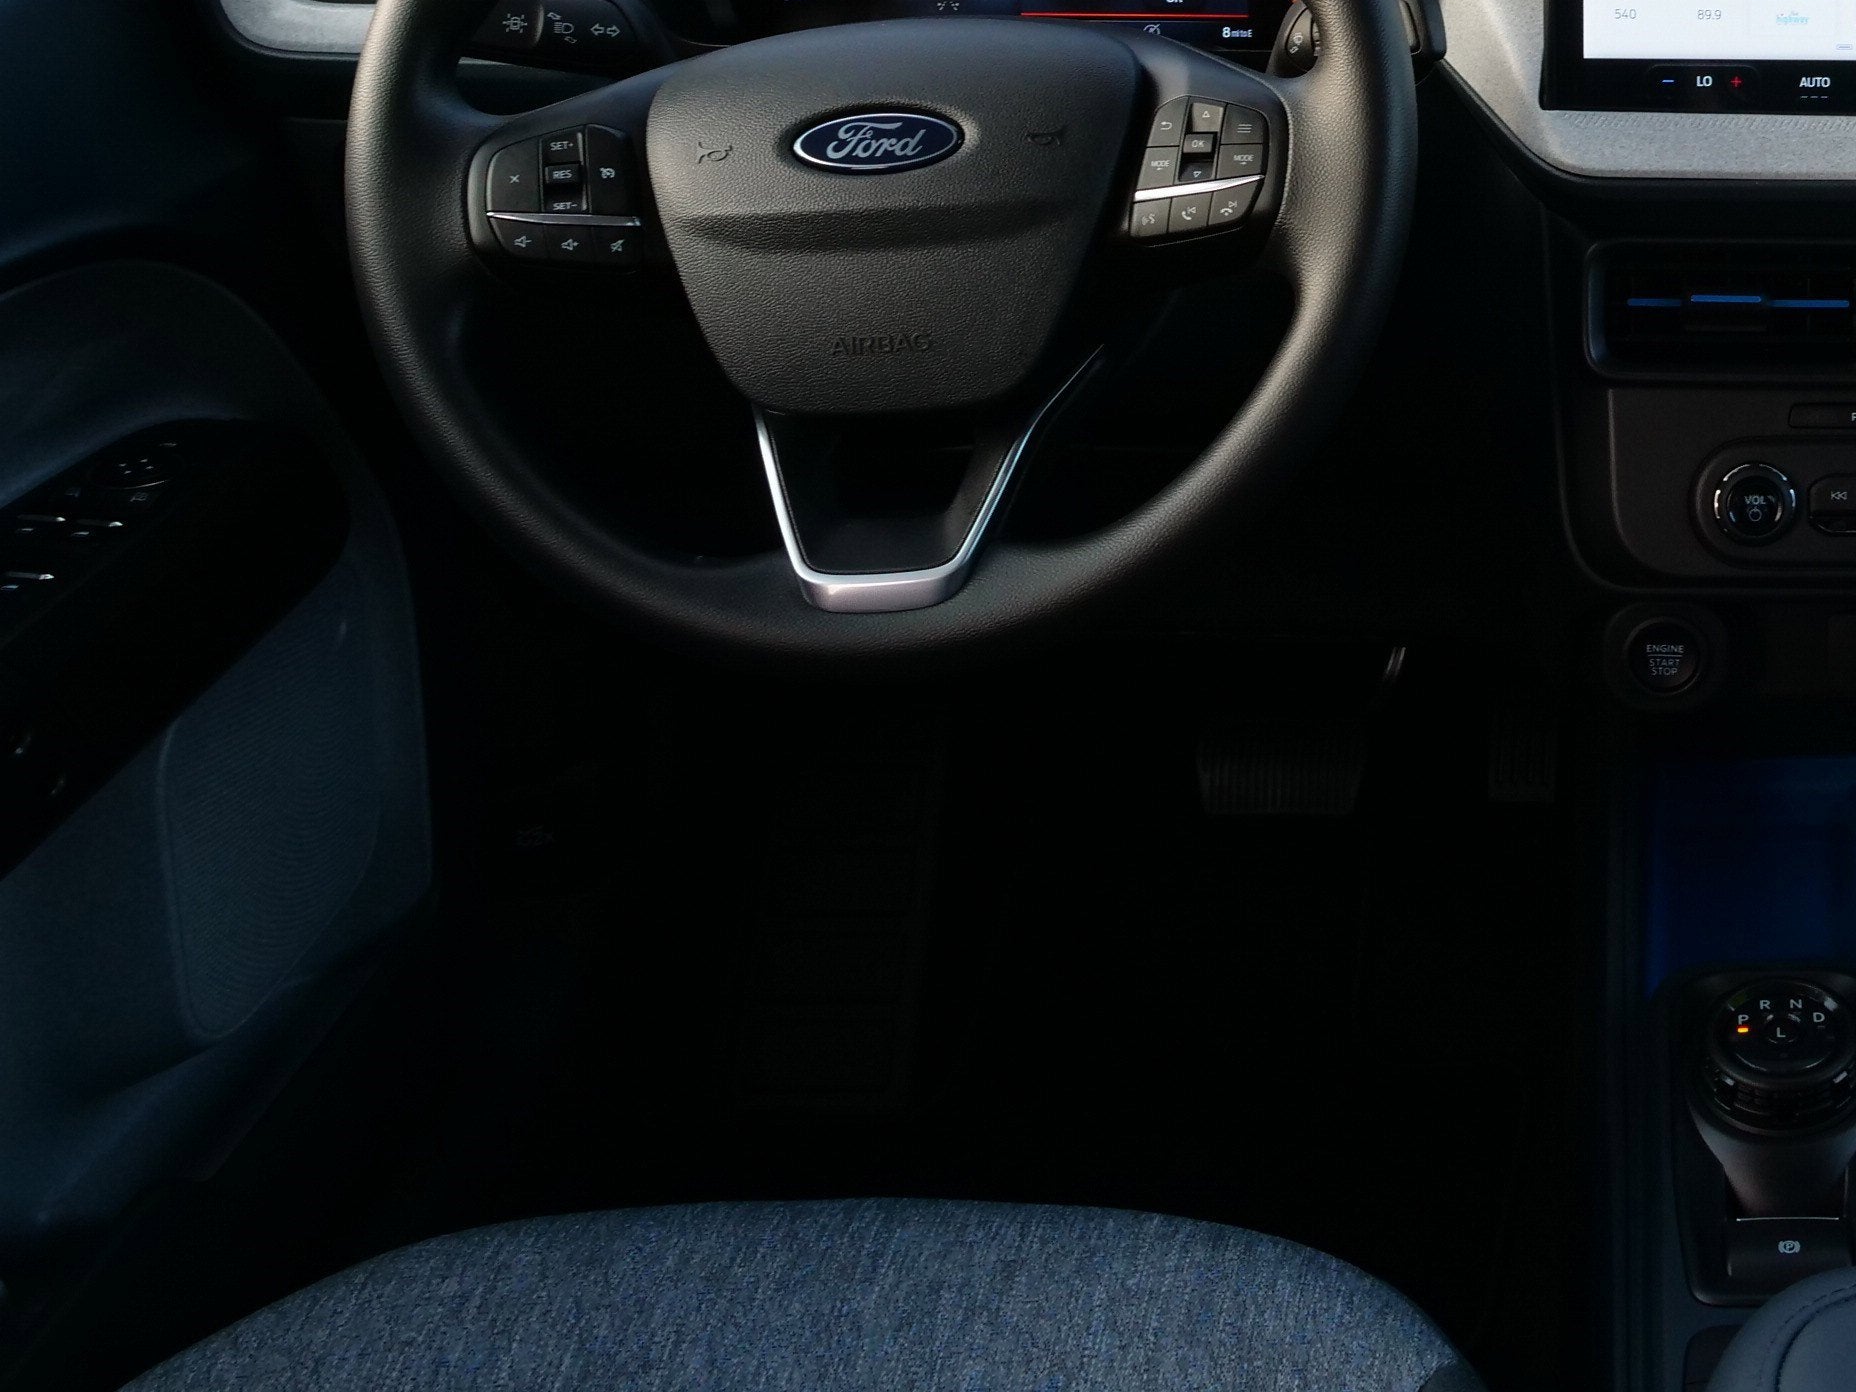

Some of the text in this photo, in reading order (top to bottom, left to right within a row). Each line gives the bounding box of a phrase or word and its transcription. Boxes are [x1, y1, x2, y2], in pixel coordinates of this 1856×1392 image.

[1614, 9, 1637, 20] 540
[1697, 10, 1722, 20] 89.9
[1696, 76, 1713, 88] LO
[1799, 76, 1831, 88] AUTO
[826, 121, 926, 159] Ford
[1191, 139, 1205, 148] OK
[1233, 154, 1254, 162] MODE
[1150, 159, 1170, 168] MODE
[552, 169, 573, 179] RES
[831, 332, 932, 357] AIRBAG
[1744, 495, 1767, 505] VOL
[1646, 644, 1684, 653] ENGINE
[1649, 658, 1680, 667] START
[1651, 667, 1678, 676] STOP
[1760, 1000, 1771, 1010] R
[1789, 999, 1803, 1009] N
[1737, 1014, 1749, 1025] P
[1813, 1012, 1825, 1023] D
[1776, 1027, 1786, 1038] L
